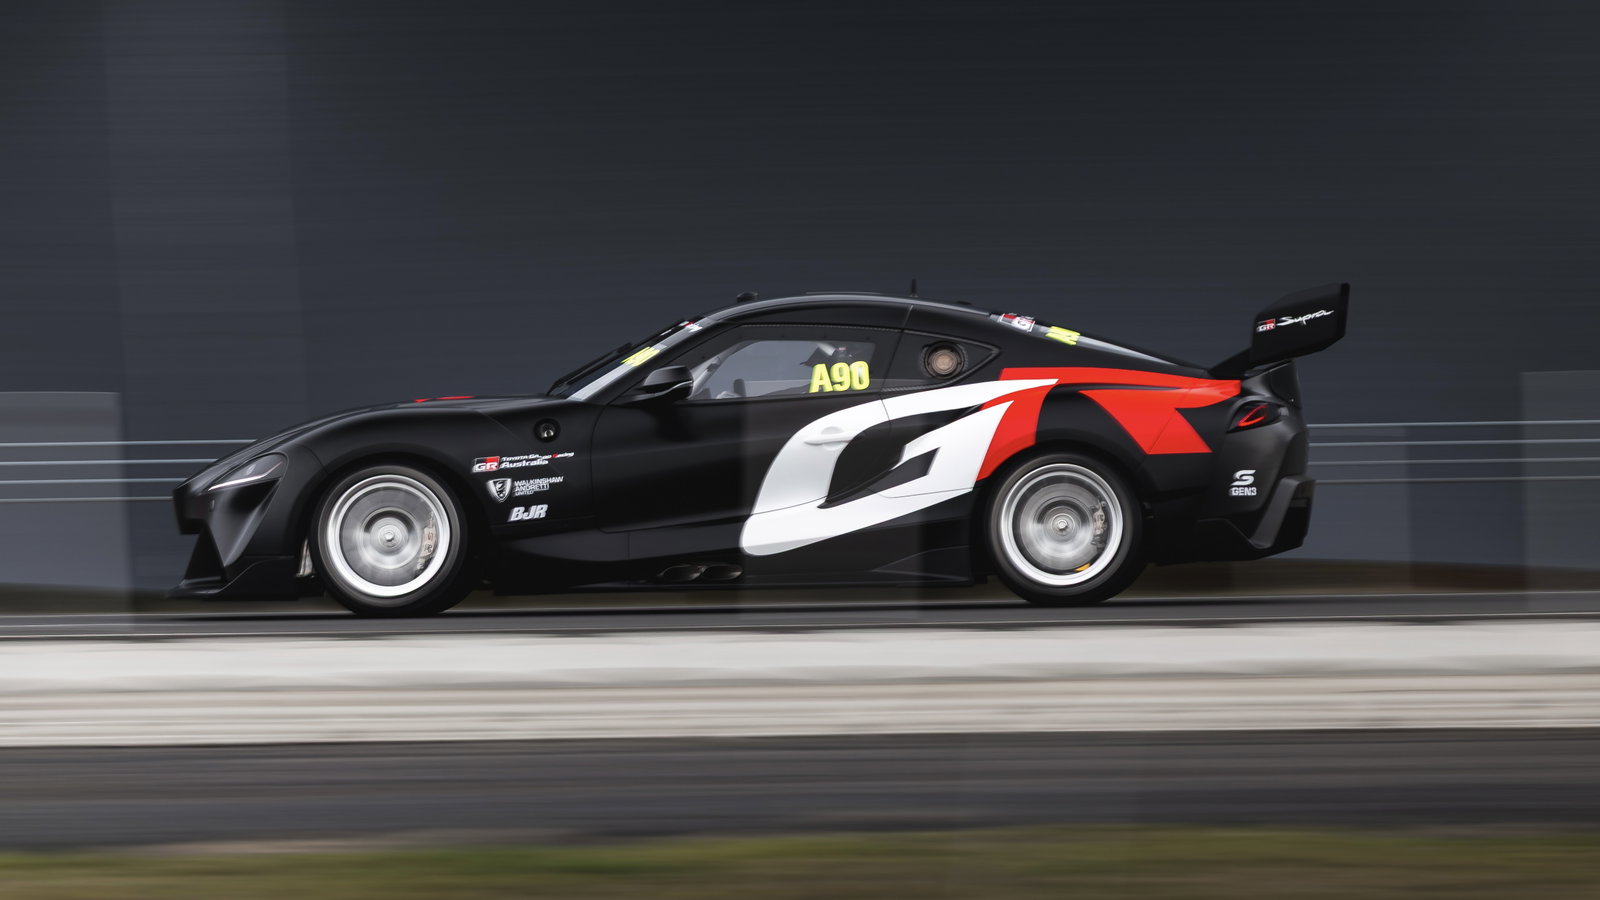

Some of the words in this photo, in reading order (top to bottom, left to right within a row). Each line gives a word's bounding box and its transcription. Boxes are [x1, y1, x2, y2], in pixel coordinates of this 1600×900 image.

[1257, 323, 1276, 332] GR
[1277, 310, 1334, 325] Supra
[809, 361, 870, 393] A90
[472, 462, 499, 472] GR
[499, 459, 549, 469] Australia
[514, 476, 564, 486] WALKINSHAW
[514, 483, 549, 492] ANDRETTI
[1230, 487, 1257, 496] GEN3
[508, 504, 548, 522] BJR
